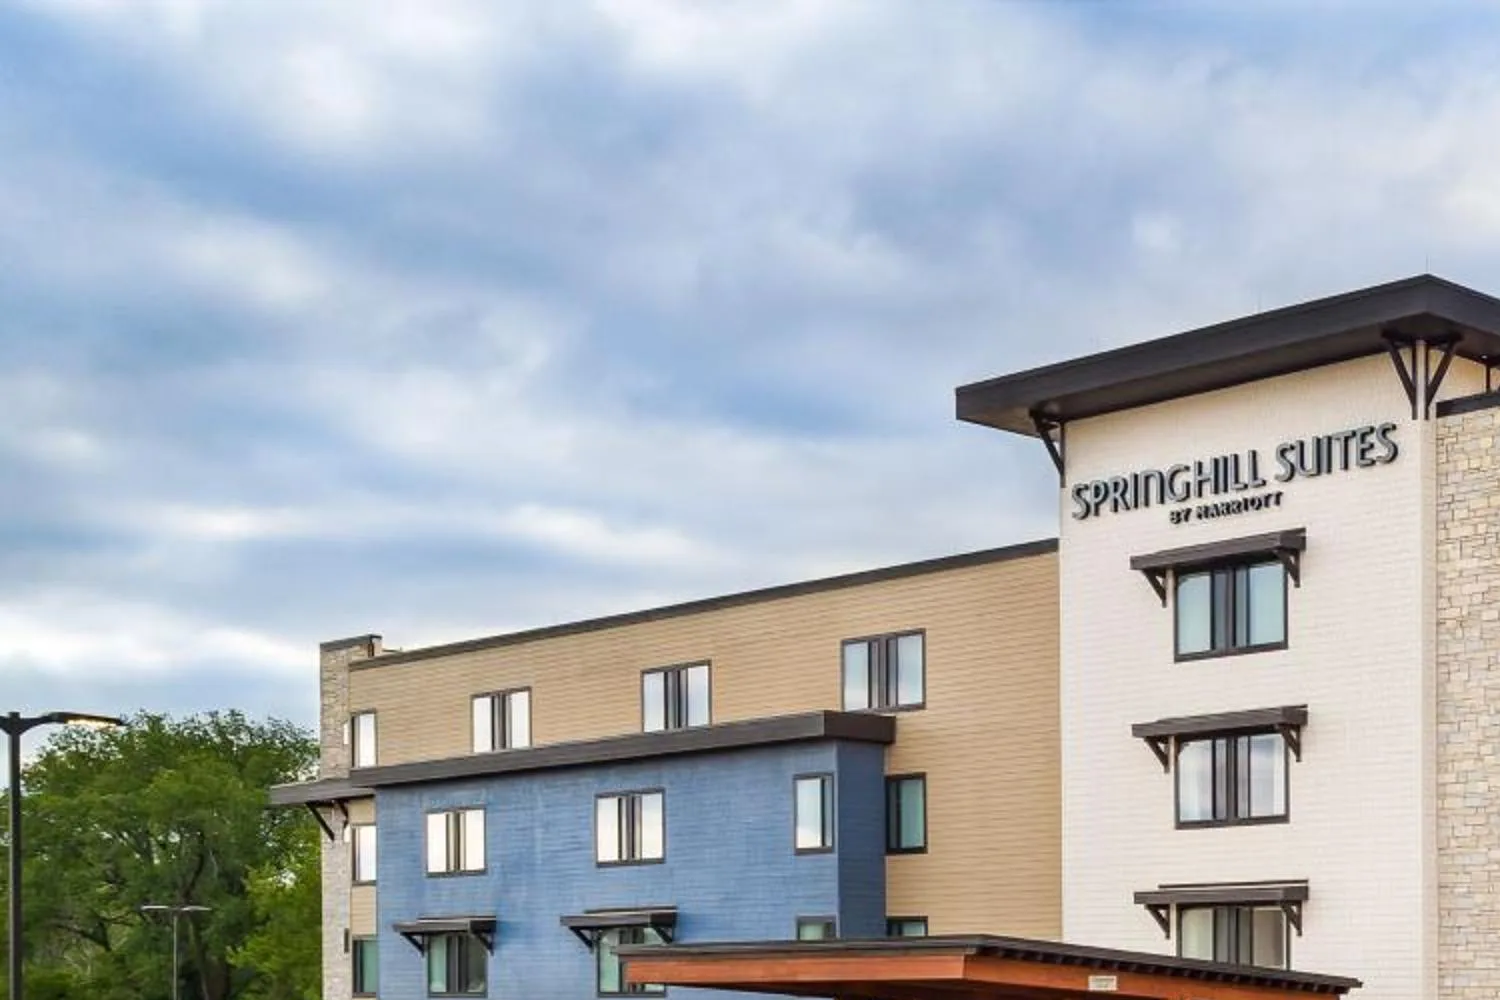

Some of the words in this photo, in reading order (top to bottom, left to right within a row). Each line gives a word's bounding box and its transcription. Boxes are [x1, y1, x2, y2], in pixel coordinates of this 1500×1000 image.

[1071, 449, 1266, 521] SPRINGHILL
[1275, 422, 1399, 484] SUITES
[1169, 507, 1192, 525] BY
[1196, 491, 1283, 520] MARRIOTT
